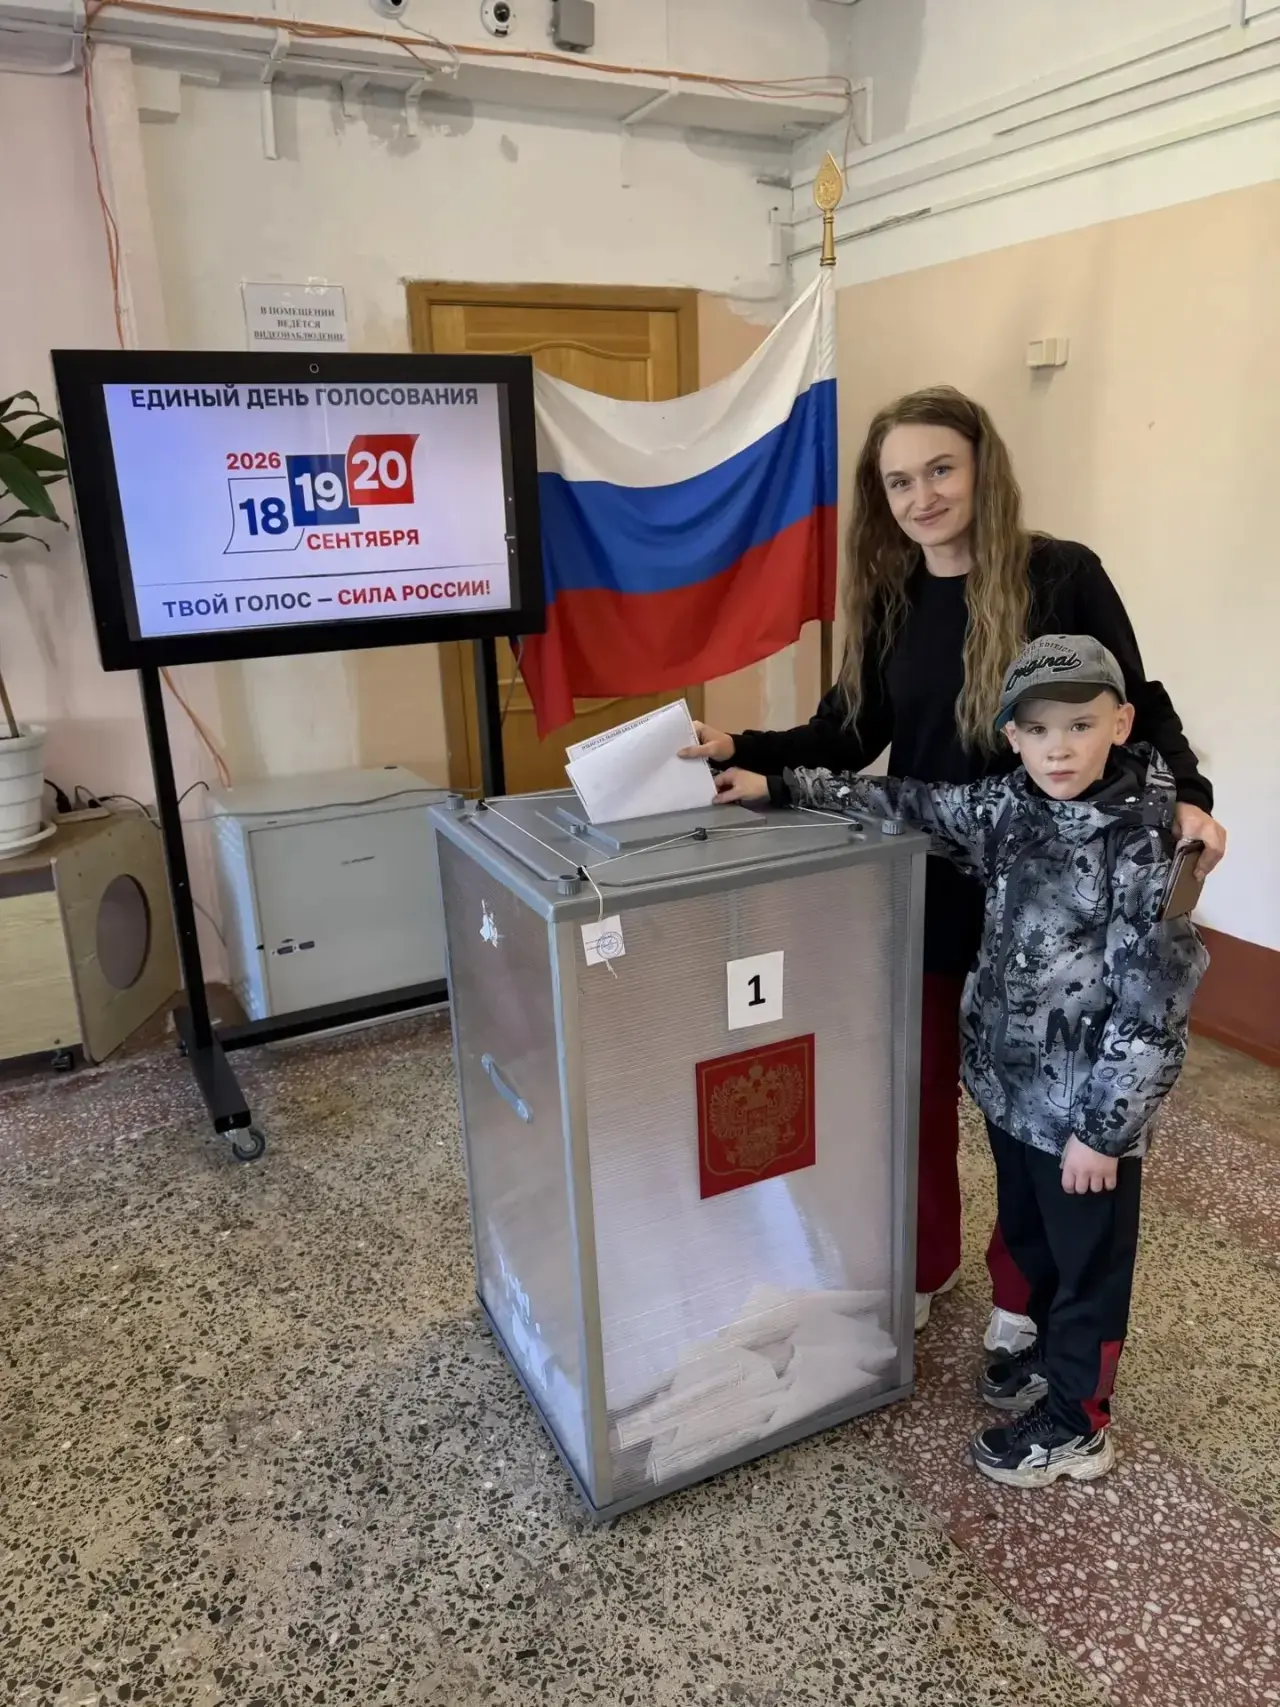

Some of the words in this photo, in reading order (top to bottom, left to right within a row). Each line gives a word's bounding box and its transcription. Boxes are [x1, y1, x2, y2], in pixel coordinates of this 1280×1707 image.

[260, 306, 267, 315] В
[269, 306, 334, 317] ПОМЕЩЕНИИ
[131, 384, 240, 409] ЕДИНЫЙ
[247, 387, 309, 410] ДЕНЬ
[316, 387, 478, 407] ГОЛОСОВАНИЯ
[226, 452, 281, 470] 2026
[351, 450, 408, 490] 20
[295, 472, 343, 512] 19
[239, 496, 289, 536] 18
[306, 529, 420, 551] СЕНТЯБРЯ
[163, 594, 229, 619] ТВОЙ
[235, 592, 311, 613] ГОЛОС
[338, 588, 396, 606] СИЛА
[402, 580, 491, 602] РОССИИ!
[748, 974, 766, 1007] 1
